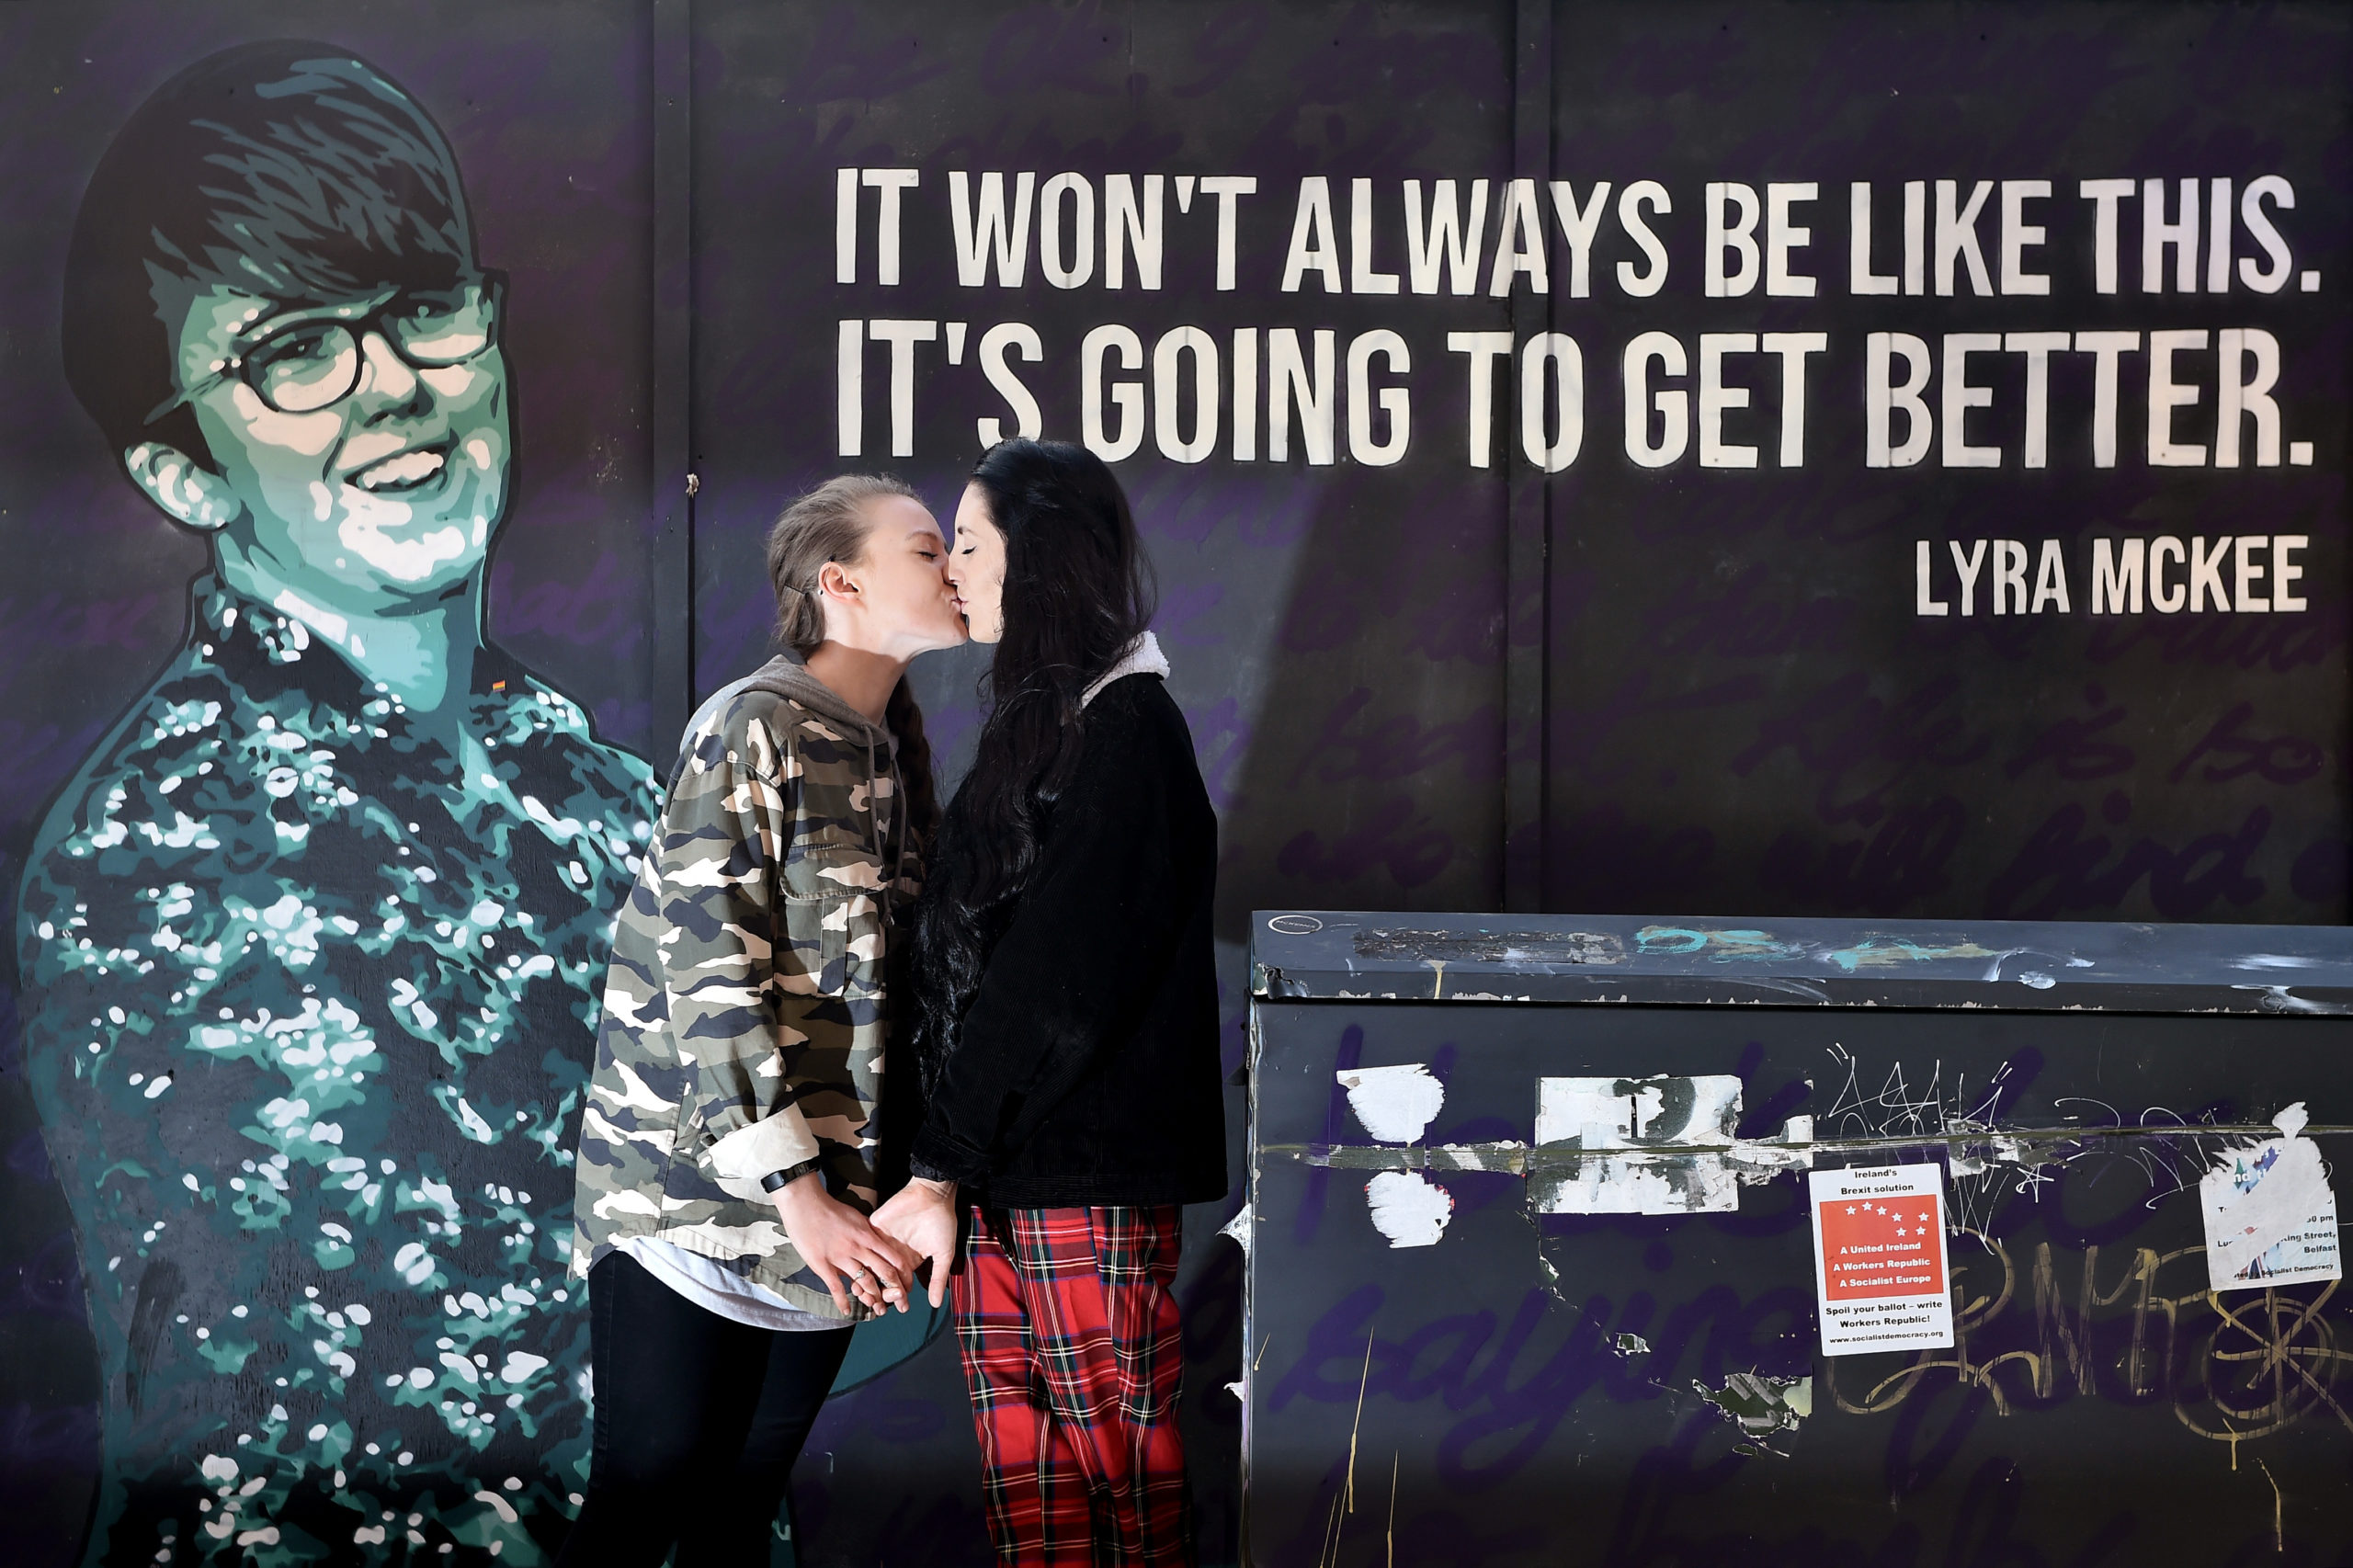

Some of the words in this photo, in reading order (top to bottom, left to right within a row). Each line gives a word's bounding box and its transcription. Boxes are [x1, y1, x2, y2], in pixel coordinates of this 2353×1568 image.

[836, 168, 919, 285] IT
[949, 172, 1256, 290] WON'T
[1281, 176, 1671, 298] ALWAYS
[1705, 182, 1818, 297] BE
[1850, 180, 2052, 297] LIKE
[2080, 176, 2321, 295] THIS.
[837, 320, 1043, 457] IT'S
[1082, 324, 1411, 467] GOING
[1448, 332, 1583, 473] TO
[1624, 332, 1827, 469] GET
[1866, 329, 2313, 469] BETTER.
[1916, 540, 2070, 616] LYRA
[2091, 536, 2309, 615] MCKEE
[1855, 1168, 1897, 1178] Ireland's
[1841, 1186, 1870, 1195] Brexit
[1874, 1183, 1914, 1192] solution
[2320, 1215, 2334, 1224] pm
[2303, 1231, 2336, 1240] Street,
[1840, 1246, 1847, 1255] A
[1850, 1244, 1883, 1254] United
[1886, 1242, 1921, 1252] Ireland
[2304, 1244, 2336, 1254] Belfast
[1833, 1264, 1840, 1272] A
[1843, 1260, 1884, 1271] Workers
[1887, 1258, 1930, 1268] Republic
[2293, 1263, 2334, 1274] Democracy
[1839, 1279, 1847, 1288] A
[1849, 1277, 1893, 1287] Socialist
[1896, 1275, 1931, 1286] Europe
[1825, 1306, 1850, 1315] Spoil
[1853, 1305, 1875, 1314] your
[1878, 1302, 1906, 1312] ballot
[1916, 1301, 1943, 1310] write
[1839, 1318, 1881, 1328] Workers
[1884, 1315, 1930, 1326] Republic!
[1829, 1331, 1944, 1344] www.socialistdemocracy.org
